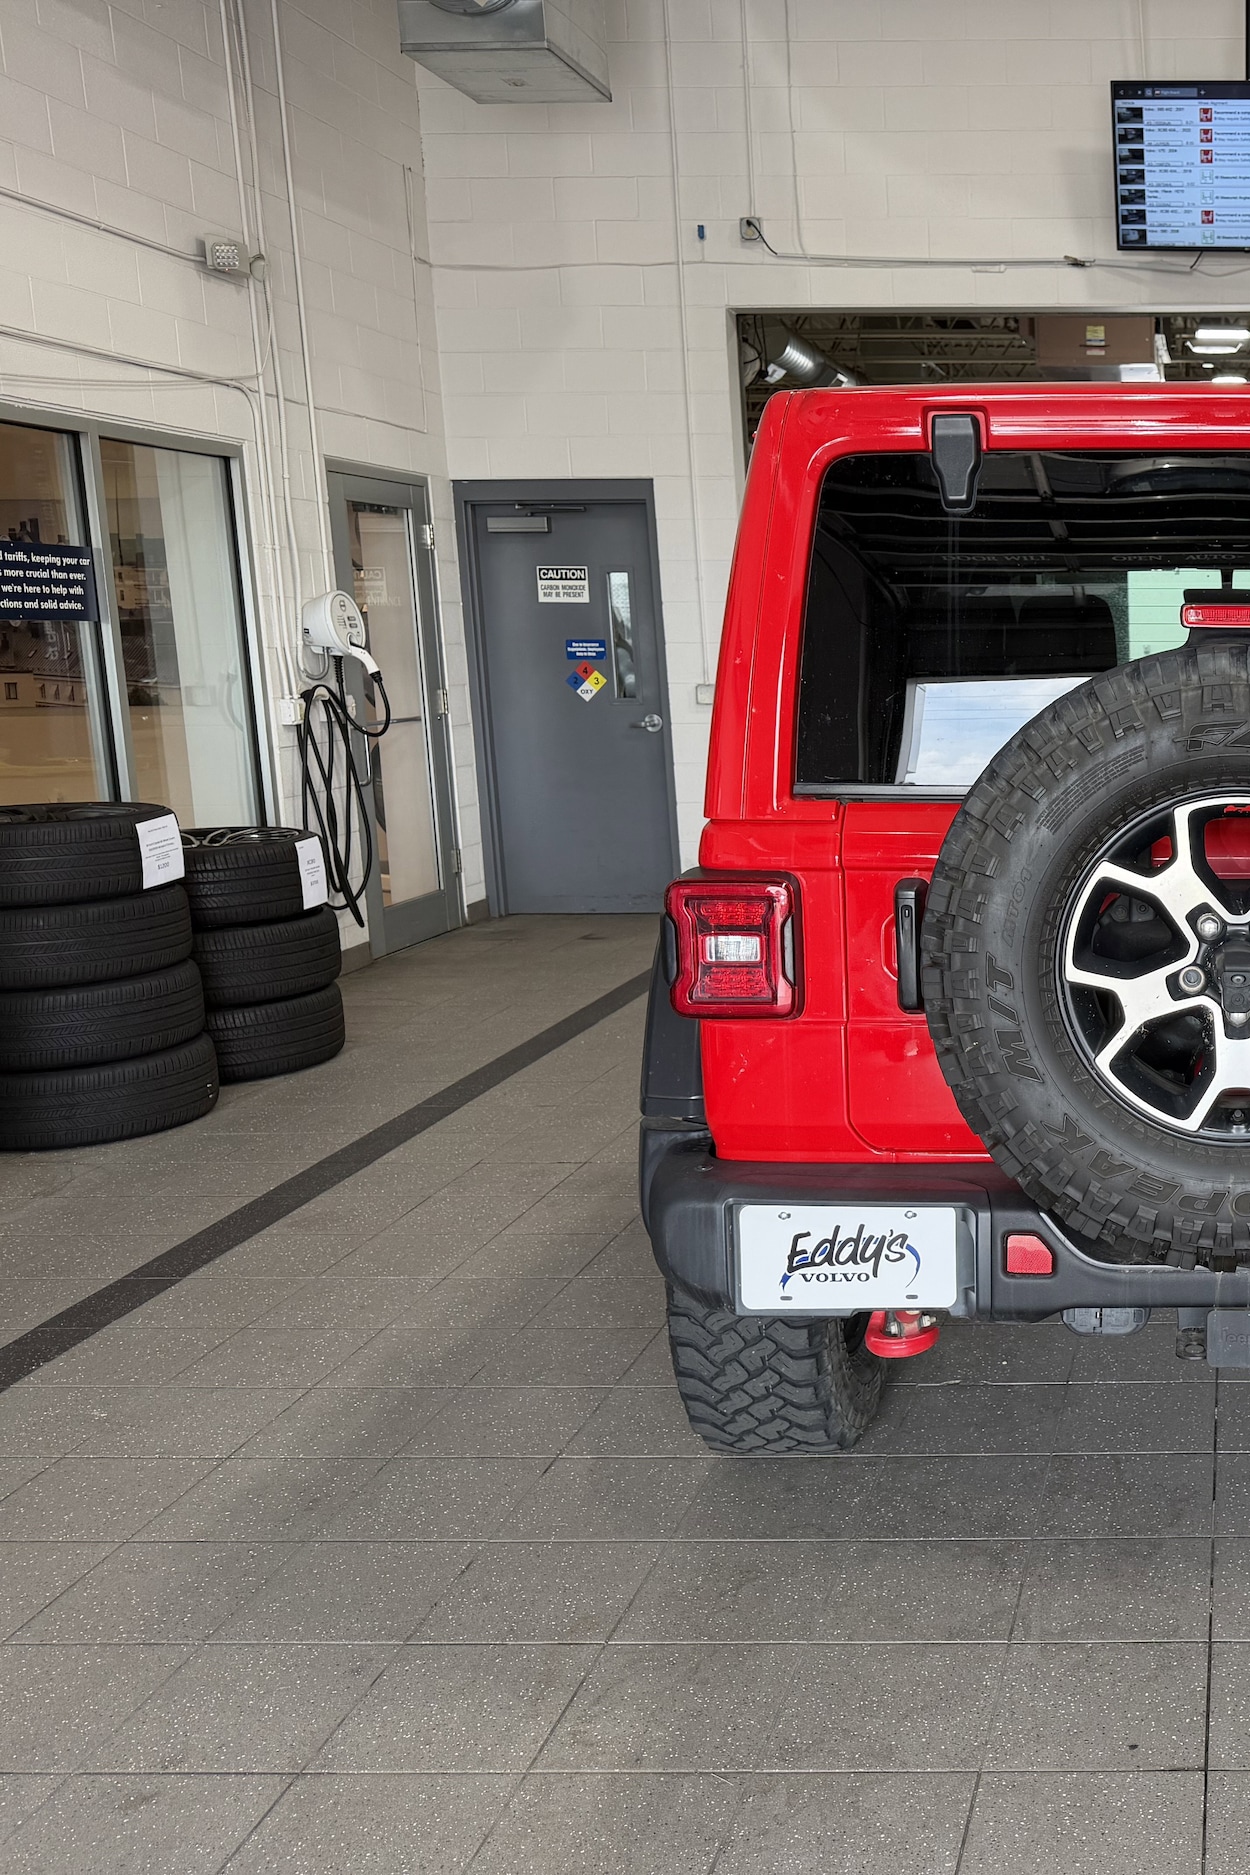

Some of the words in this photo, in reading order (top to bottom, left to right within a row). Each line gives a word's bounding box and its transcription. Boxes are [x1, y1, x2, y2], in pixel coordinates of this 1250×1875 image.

[4, 552, 30, 564] tariffs,
[31, 553, 61, 566] keeping
[62, 557, 78, 566] your
[79, 558, 91, 566] car
[3, 569, 24, 577] more
[25, 569, 50, 579] crucial
[51, 569, 68, 579] than
[69, 572, 87, 580] ever.
[540, 569, 585, 579] CAUTION
[1, 583, 22, 593] we're
[23, 583, 41, 594] here
[42, 585, 50, 594] to
[51, 583, 68, 596] help
[69, 585, 85, 595] with
[24, 599, 39, 609] and
[40, 599, 58, 610] solid
[59, 600, 85, 610] advice.
[582, 666, 588, 675] 4
[573, 676, 579, 685] 2
[593, 676, 600, 686] 3
[786, 1224, 909, 1279] Eddy's
[798, 1272, 870, 1283] VOLVO
